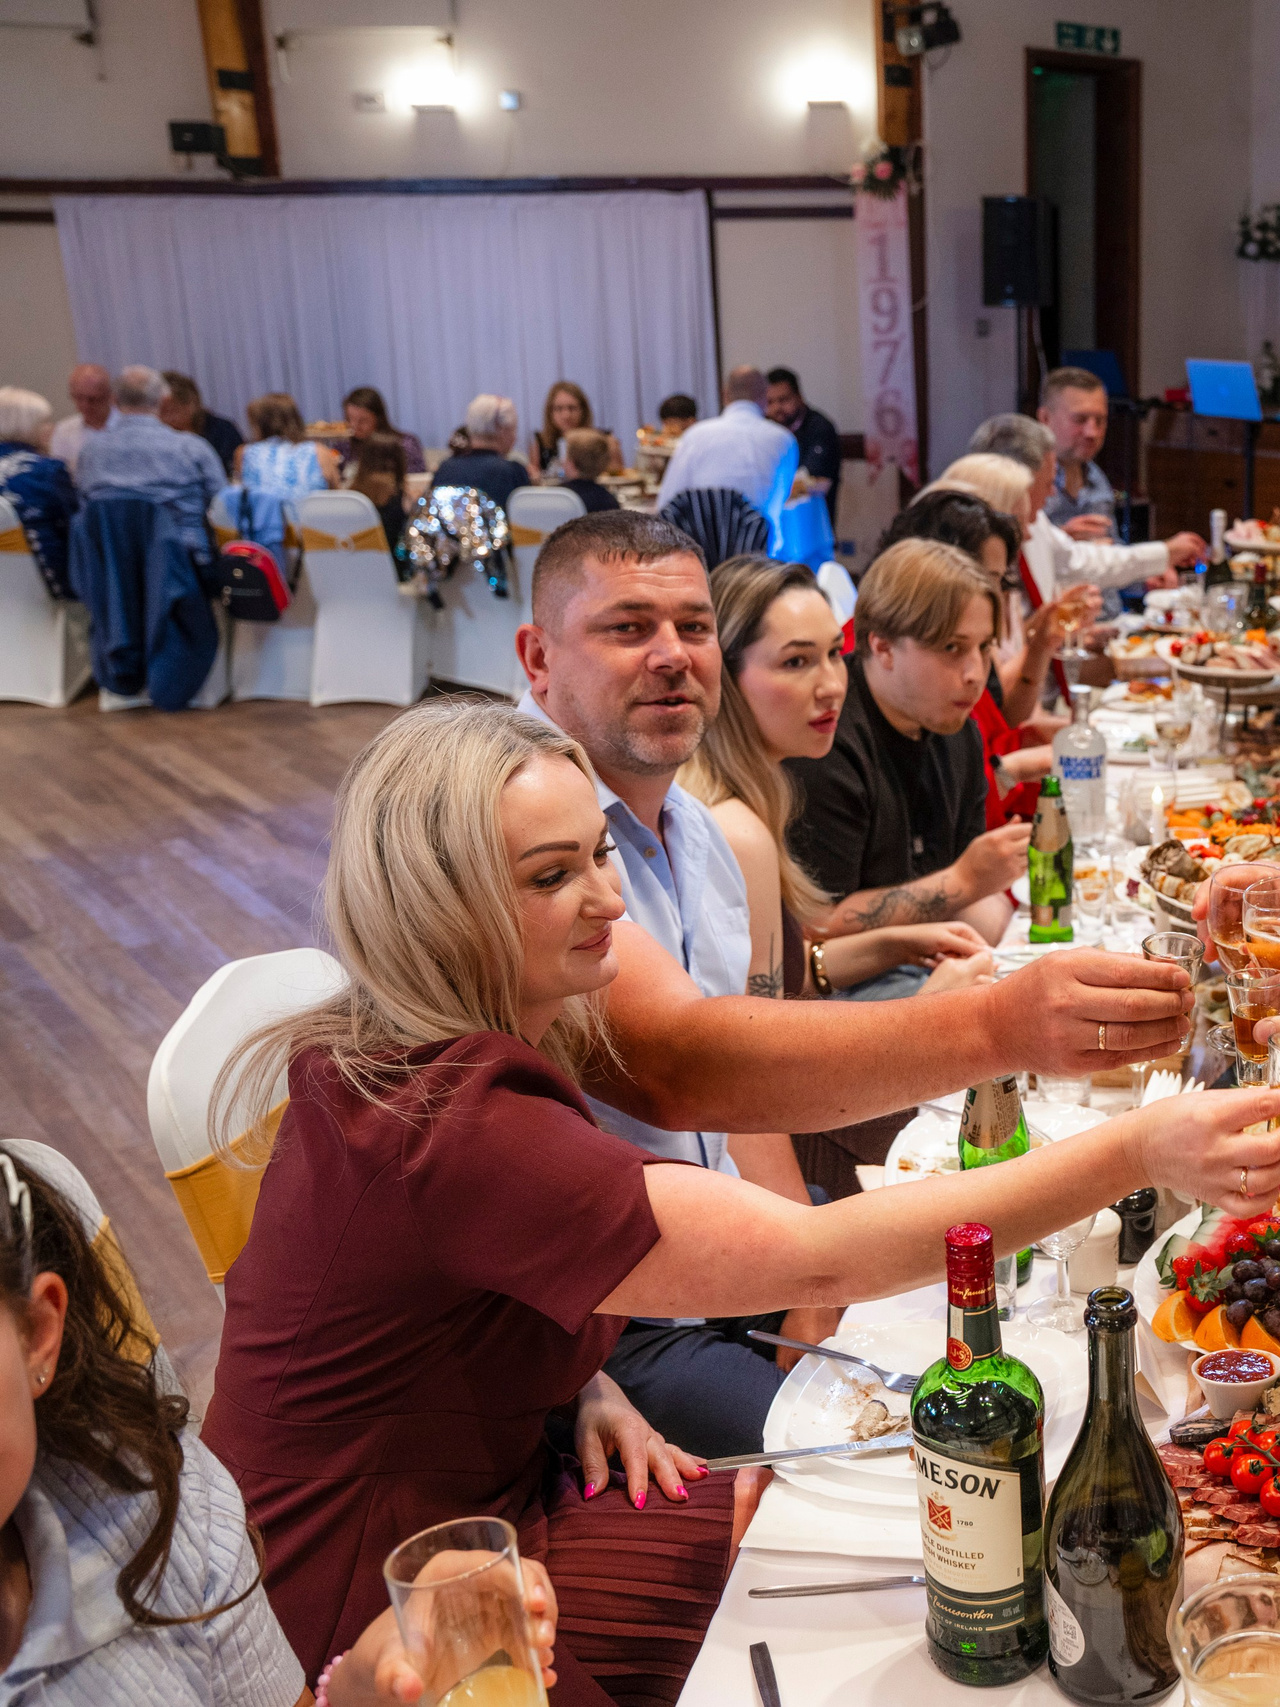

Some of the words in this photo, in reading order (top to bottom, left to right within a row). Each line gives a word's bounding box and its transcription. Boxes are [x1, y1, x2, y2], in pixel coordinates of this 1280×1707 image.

[867, 234, 906, 439] 1976
[1058, 754, 1104, 767] ABSOLUT
[1063, 766, 1101, 779] VODKA
[956, 1519, 974, 1527] 1780
[937, 1543, 984, 1560] DISTILLED
[937, 1554, 976, 1571] WHISKEY
[954, 1623, 984, 1632] IRELAND
